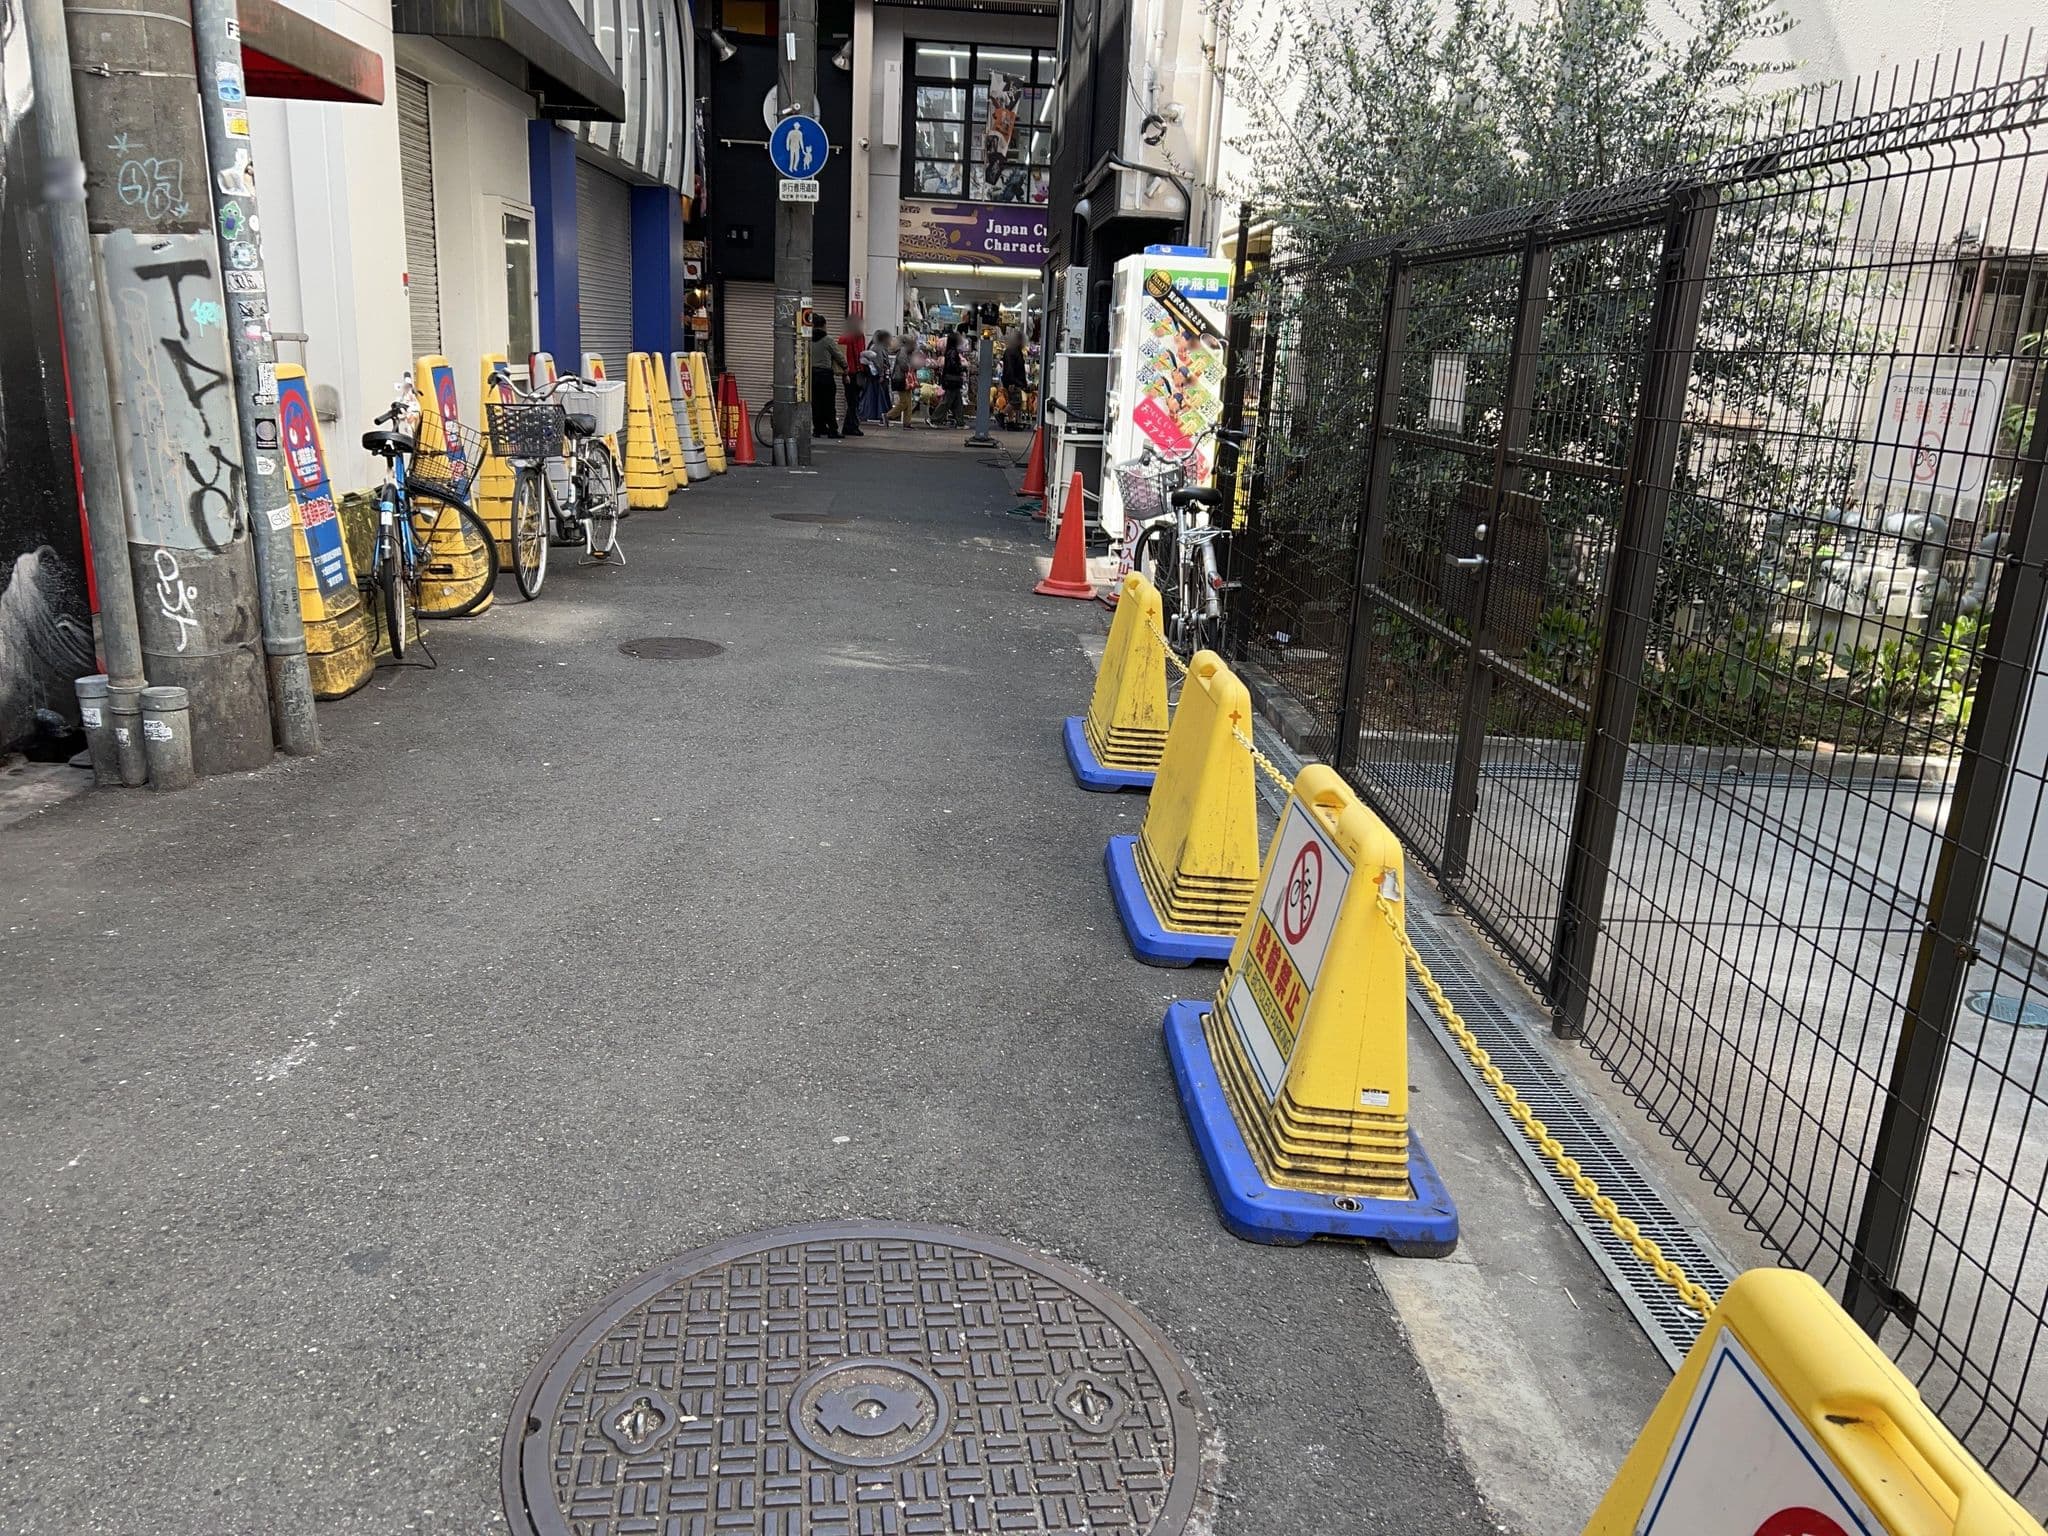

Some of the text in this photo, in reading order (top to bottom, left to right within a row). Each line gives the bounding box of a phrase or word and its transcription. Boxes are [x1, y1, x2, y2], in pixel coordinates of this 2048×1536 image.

[986, 218, 1028, 236] Japan
[1255, 923, 1302, 1024] 駐輪禁止
